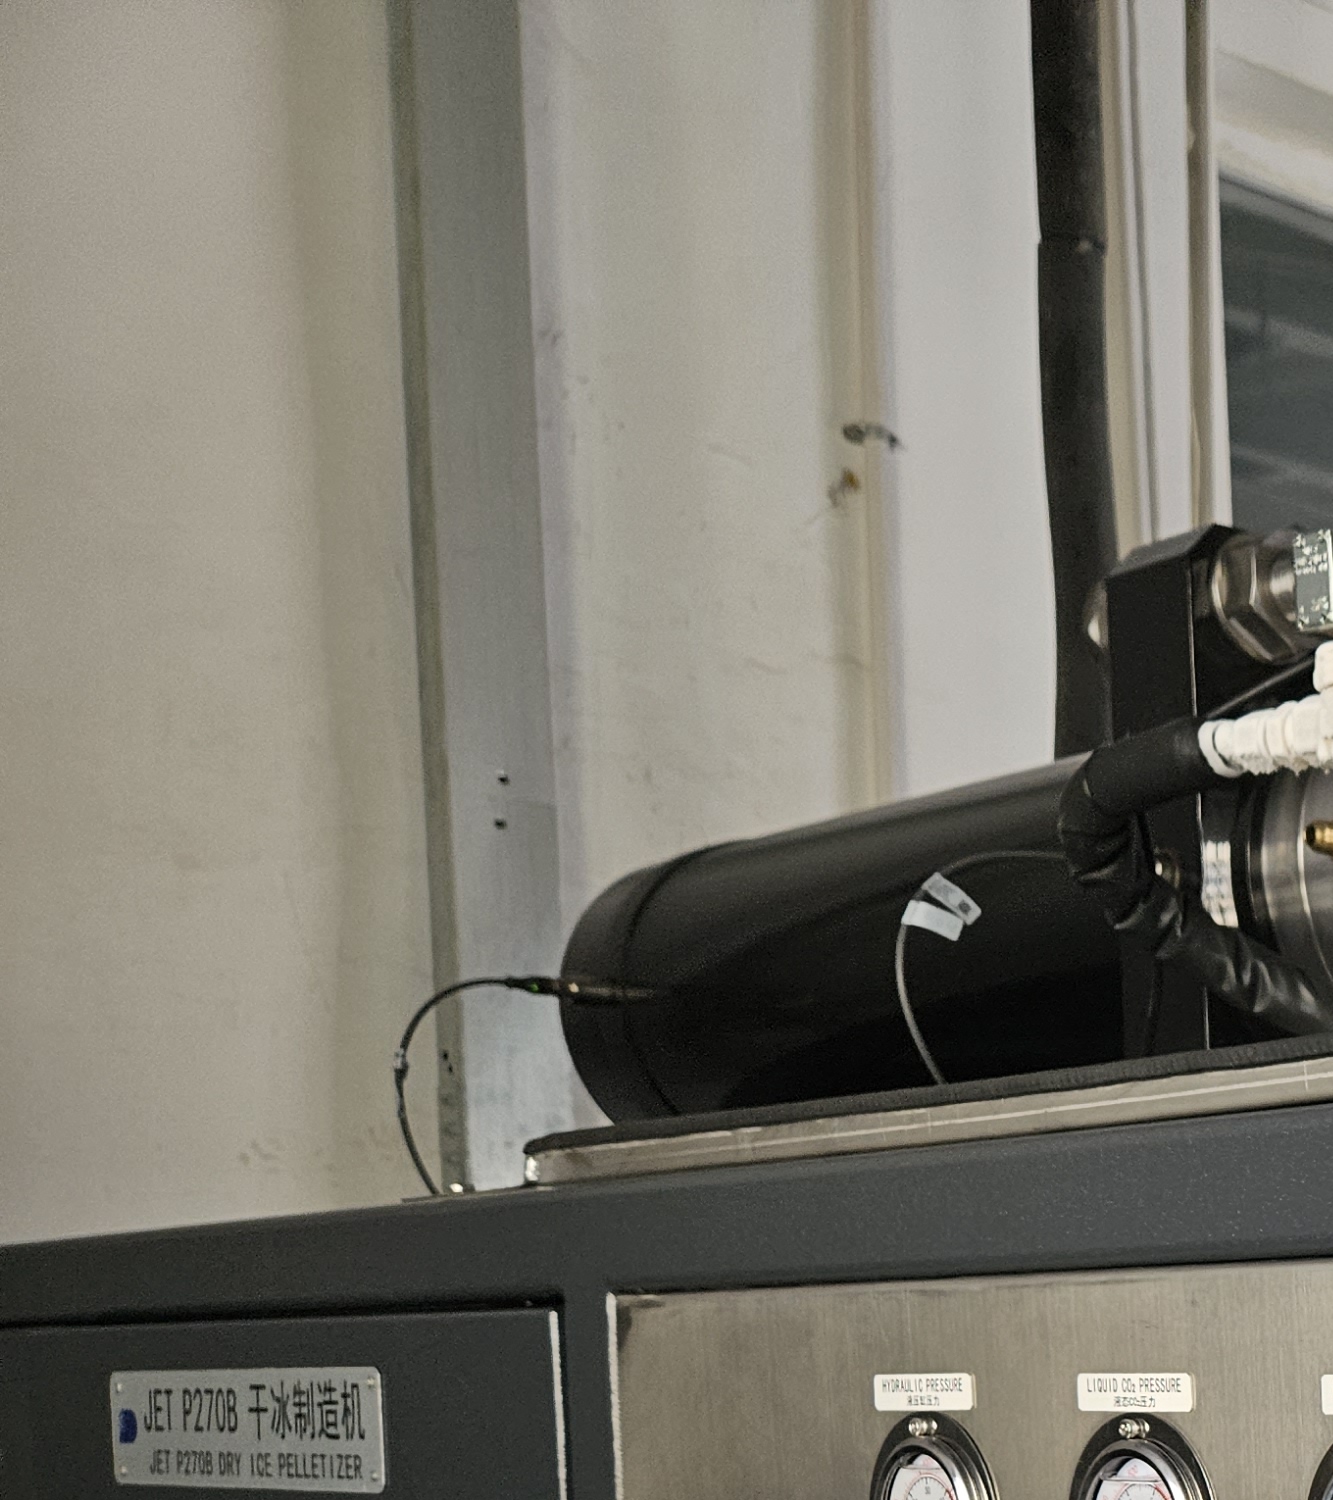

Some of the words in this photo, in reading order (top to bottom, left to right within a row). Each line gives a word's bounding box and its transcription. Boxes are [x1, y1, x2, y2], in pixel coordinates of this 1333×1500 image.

[882, 1378, 923, 1393] HYDRAULIC
[926, 1377, 963, 1392] PRESSURE
[1086, 1377, 1119, 1393] LIQUID
[1139, 1377, 1182, 1393] PRESSURE
[144, 1387, 172, 1432] JET
[182, 1387, 238, 1432] P270B
[248, 1379, 365, 1441] 干冰制造机
[150, 1449, 170, 1475] JET
[177, 1450, 213, 1475] P270B
[218, 1451, 241, 1476] DRY
[251, 1452, 272, 1477] ICE
[278, 1453, 362, 1479] PELLETIZER
